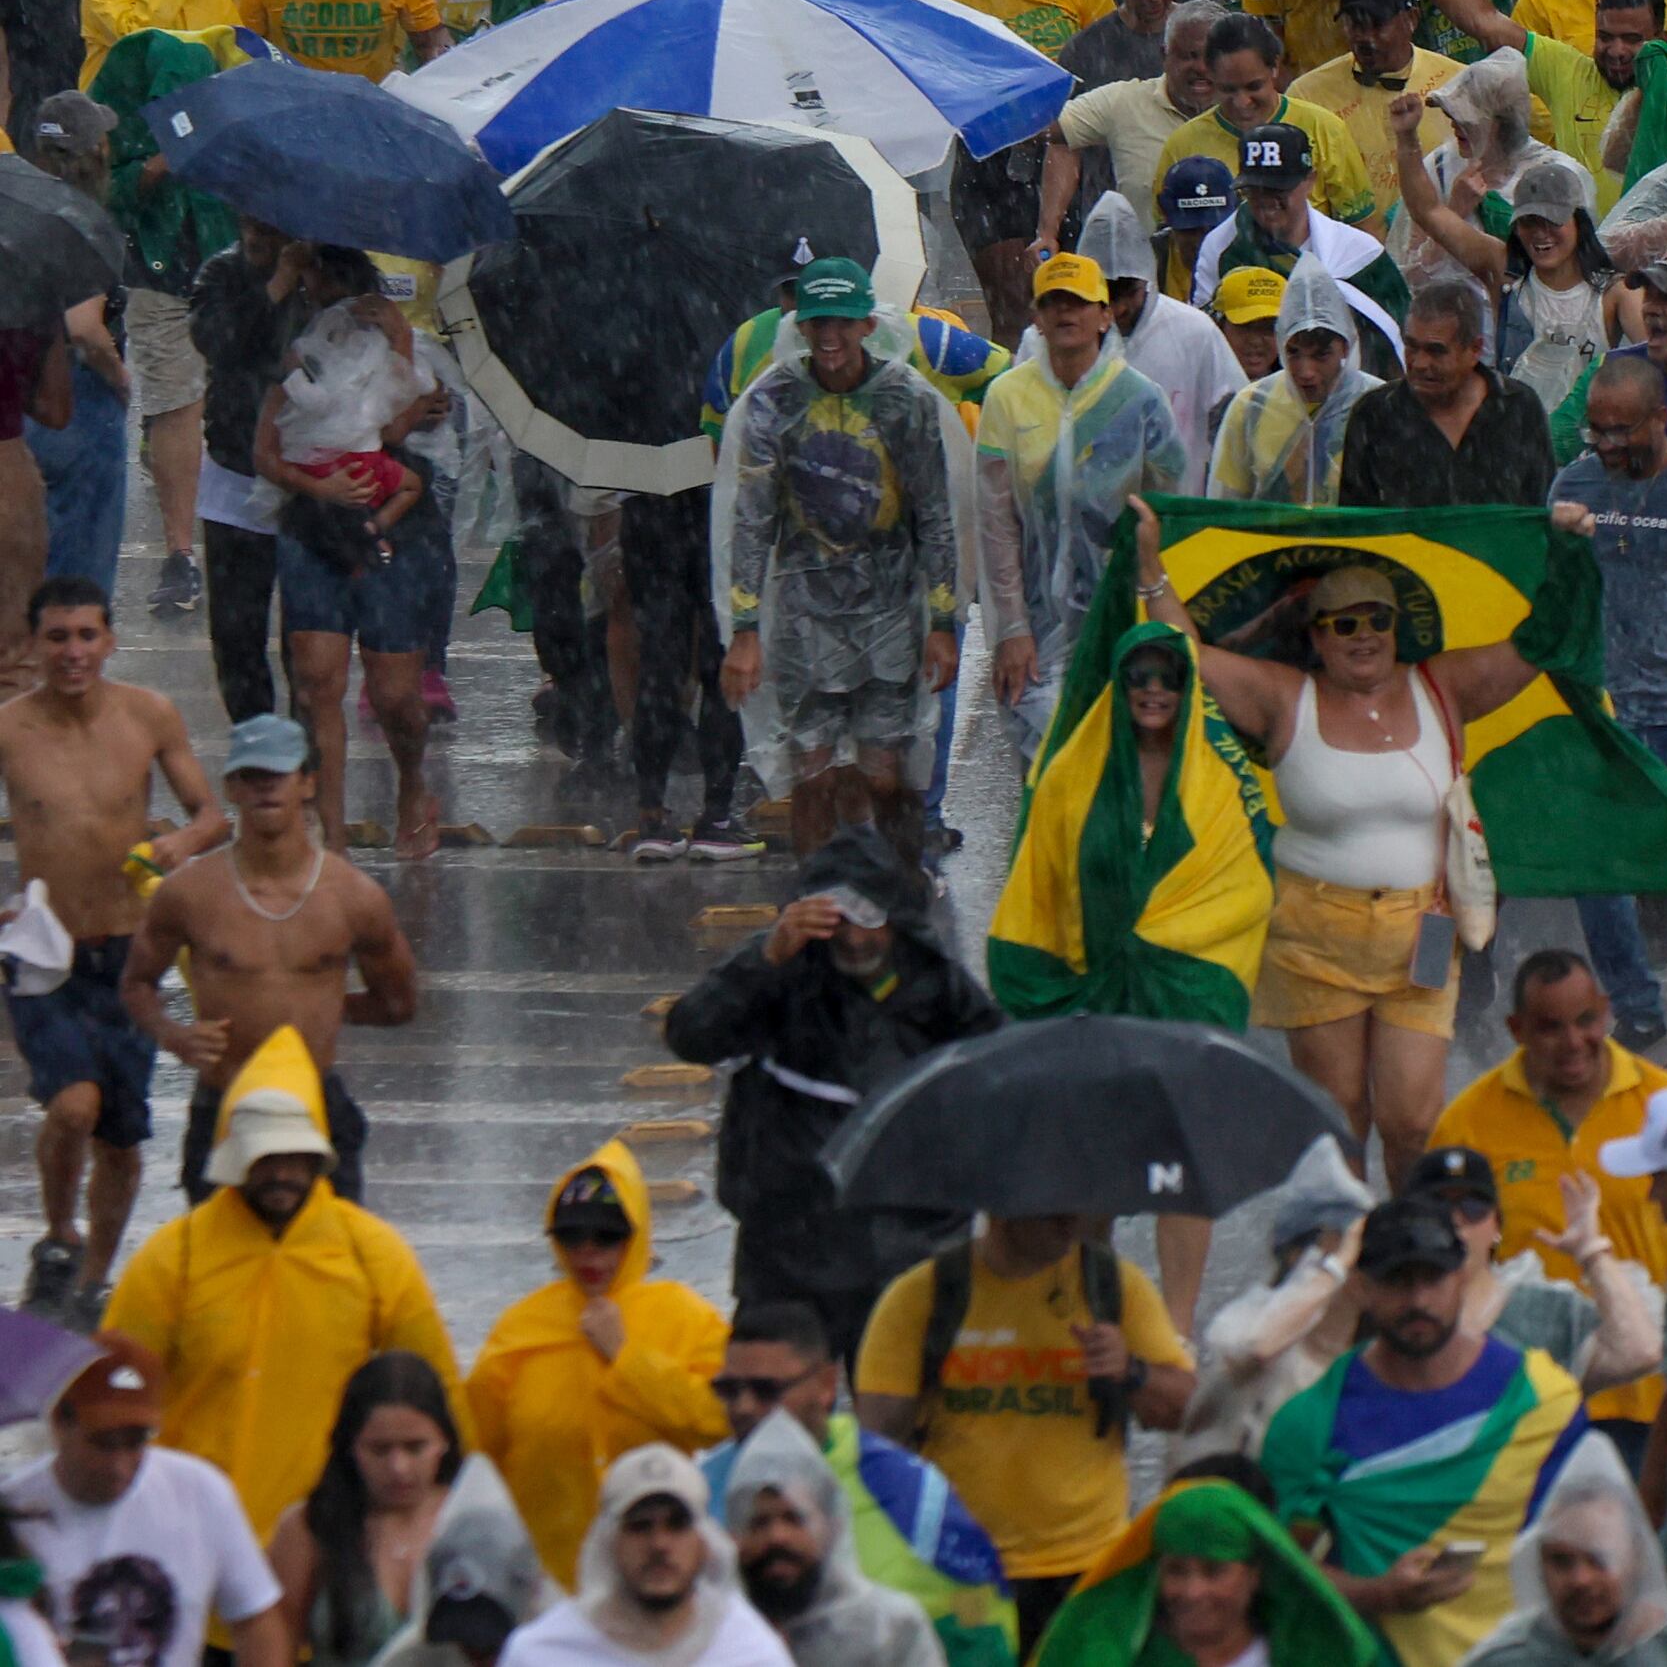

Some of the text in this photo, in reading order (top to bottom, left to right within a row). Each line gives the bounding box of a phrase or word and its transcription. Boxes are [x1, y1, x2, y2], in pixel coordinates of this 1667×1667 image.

[282, 1, 382, 26] ACORDA
[1245, 141, 1282, 166] PR
[1179, 198, 1226, 207] NACIONAL
[1594, 511, 1628, 526] cific
[1185, 561, 1260, 632] BRASIL
[1398, 581, 1437, 650] TUDO
[1147, 1161, 1184, 1194] N
[942, 1350, 1086, 1382] NOVO
[943, 1386, 1083, 1416] BRASIL
